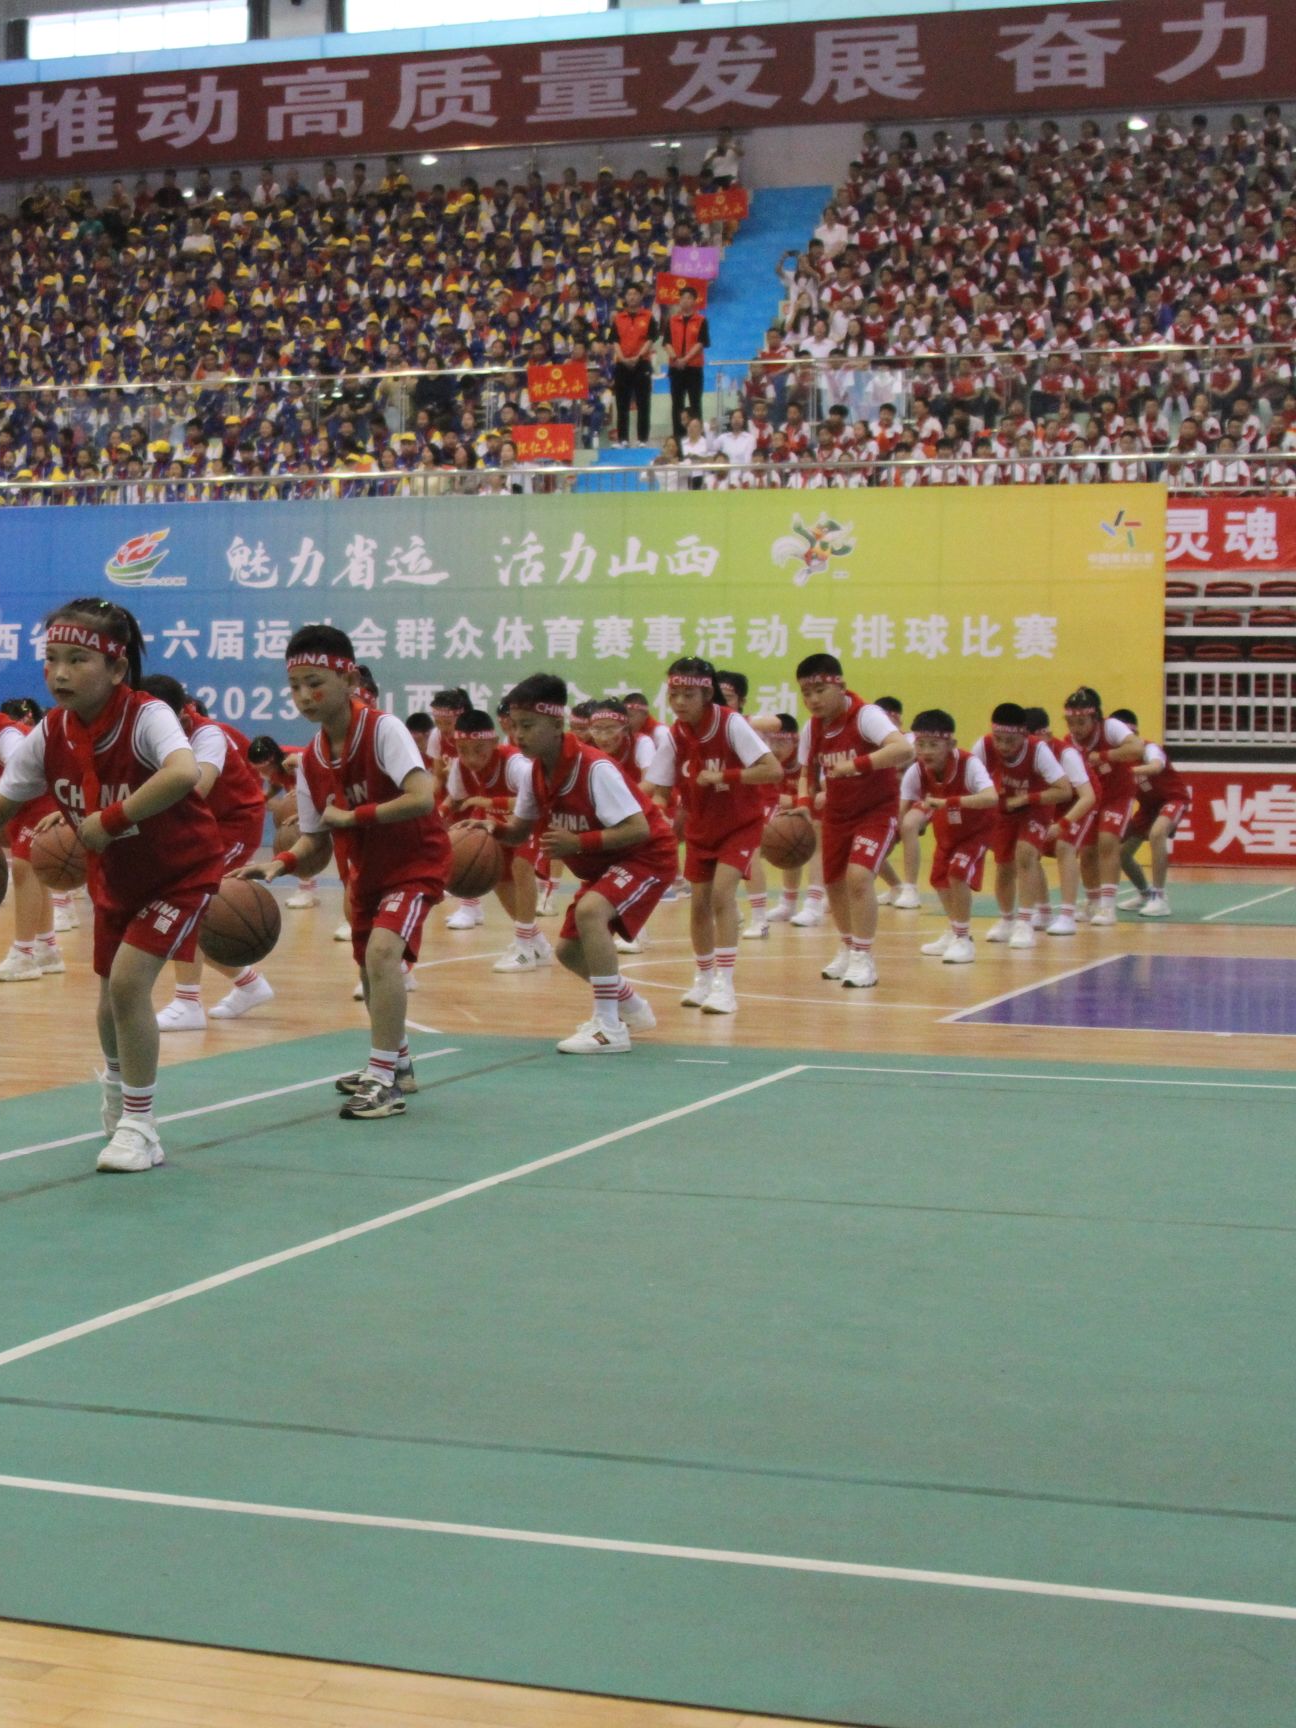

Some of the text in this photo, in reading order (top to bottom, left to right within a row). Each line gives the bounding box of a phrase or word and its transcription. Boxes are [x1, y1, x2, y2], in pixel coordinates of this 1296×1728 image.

[14, 24, 926, 161] 推动高质量发展
[997, 2, 1269, 94] 奋力
[226, 532, 720, 590] 魅力省运 活力山西
[1166, 507, 1279, 562] 灵魂
[550, 812, 590, 832] HINA
